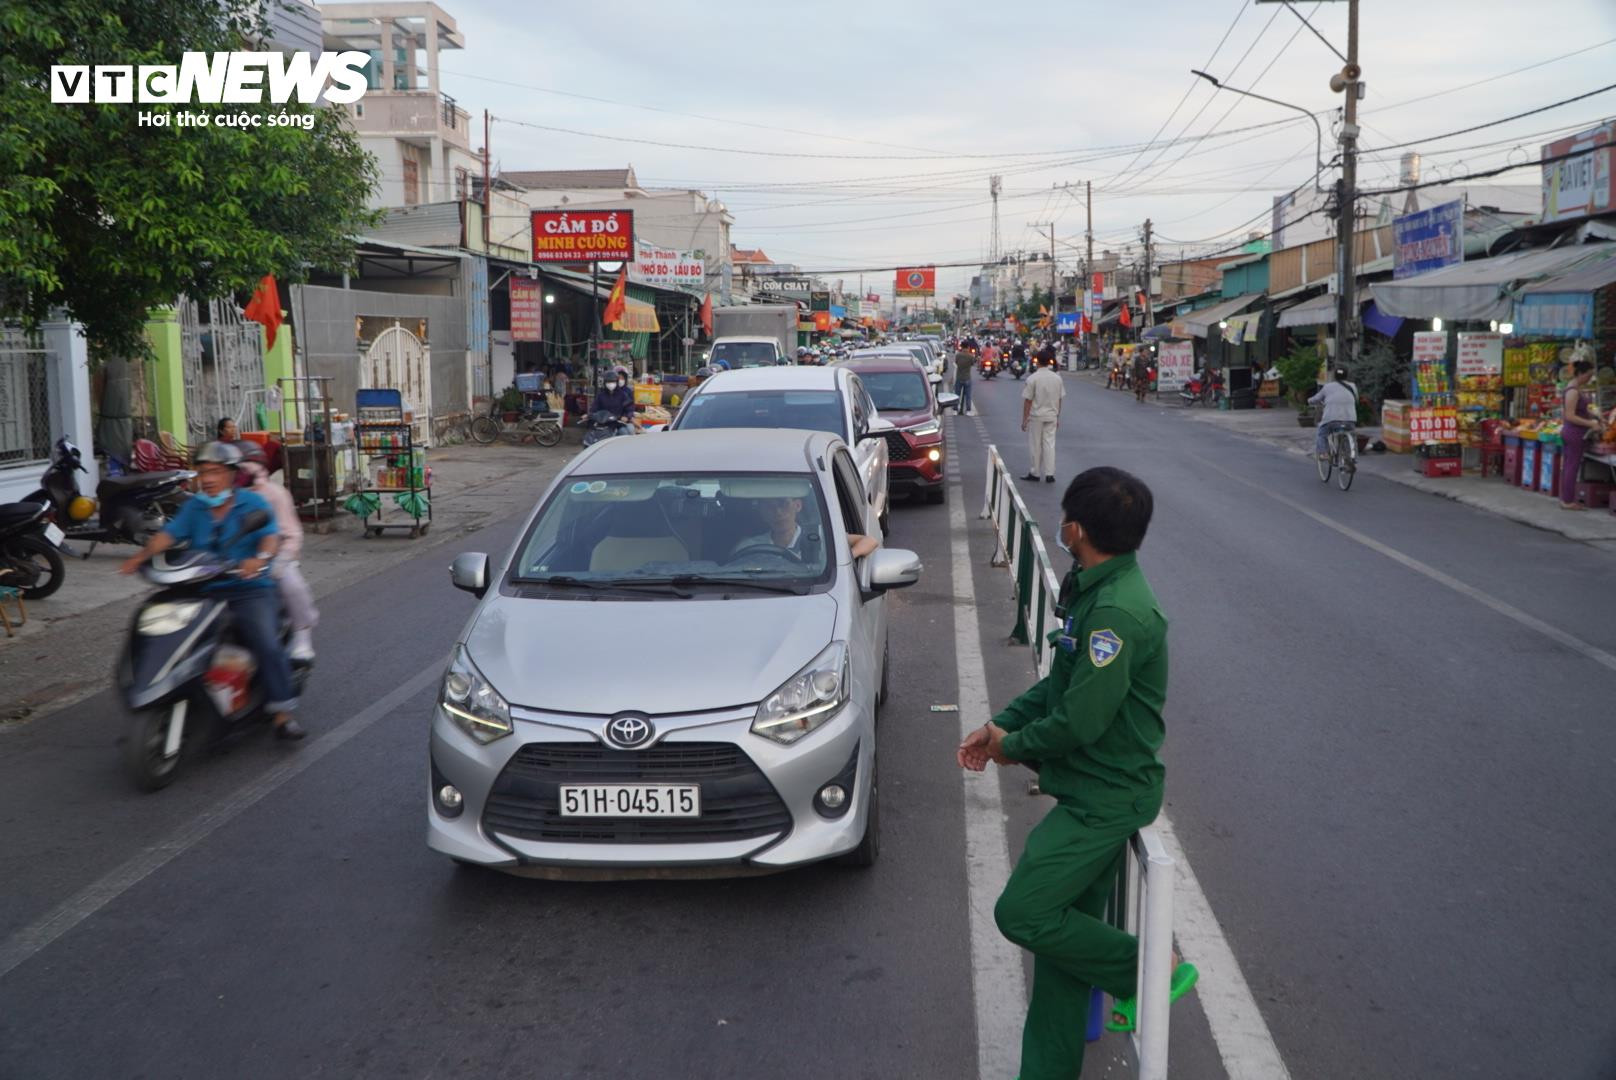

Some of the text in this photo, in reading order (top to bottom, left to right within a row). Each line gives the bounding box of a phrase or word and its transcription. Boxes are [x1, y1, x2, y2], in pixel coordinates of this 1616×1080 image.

[544, 212, 619, 234] CẦM ĐỒ
[538, 236, 575, 250] MINH
[565, 789, 693, 813] 51H-045.15
